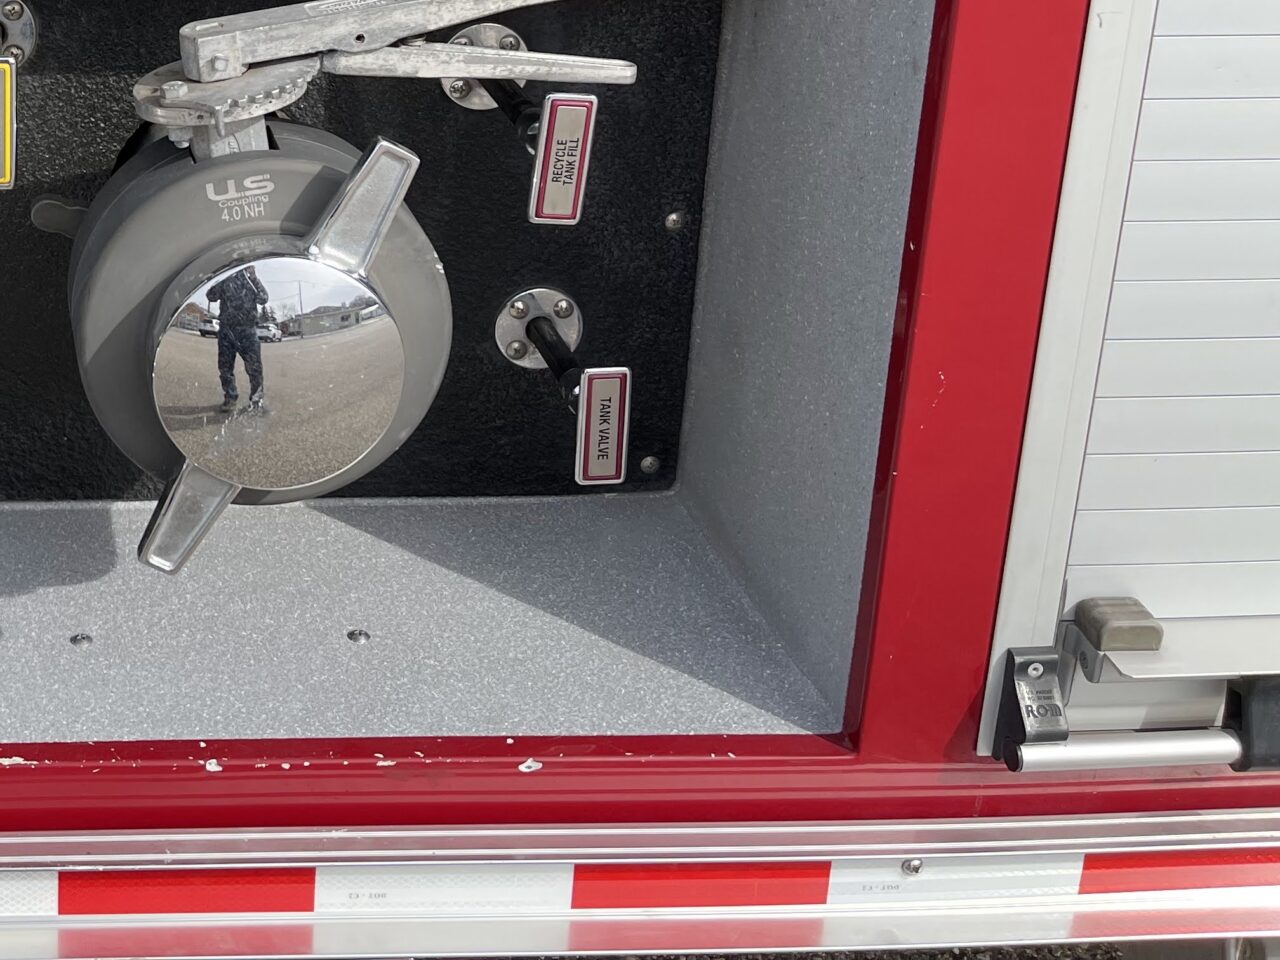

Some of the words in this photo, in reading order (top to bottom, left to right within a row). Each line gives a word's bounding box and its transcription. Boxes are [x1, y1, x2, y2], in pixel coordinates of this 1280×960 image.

[567, 137, 579, 157] FILL
[552, 139, 568, 183] RECYCLE
[563, 159, 576, 186] TANK
[218, 194, 269, 207] Coupling
[221, 206, 242, 222] 4.0
[244, 203, 265, 218] NH
[599, 397, 611, 426] TANK
[598, 428, 610, 461] VALVE
